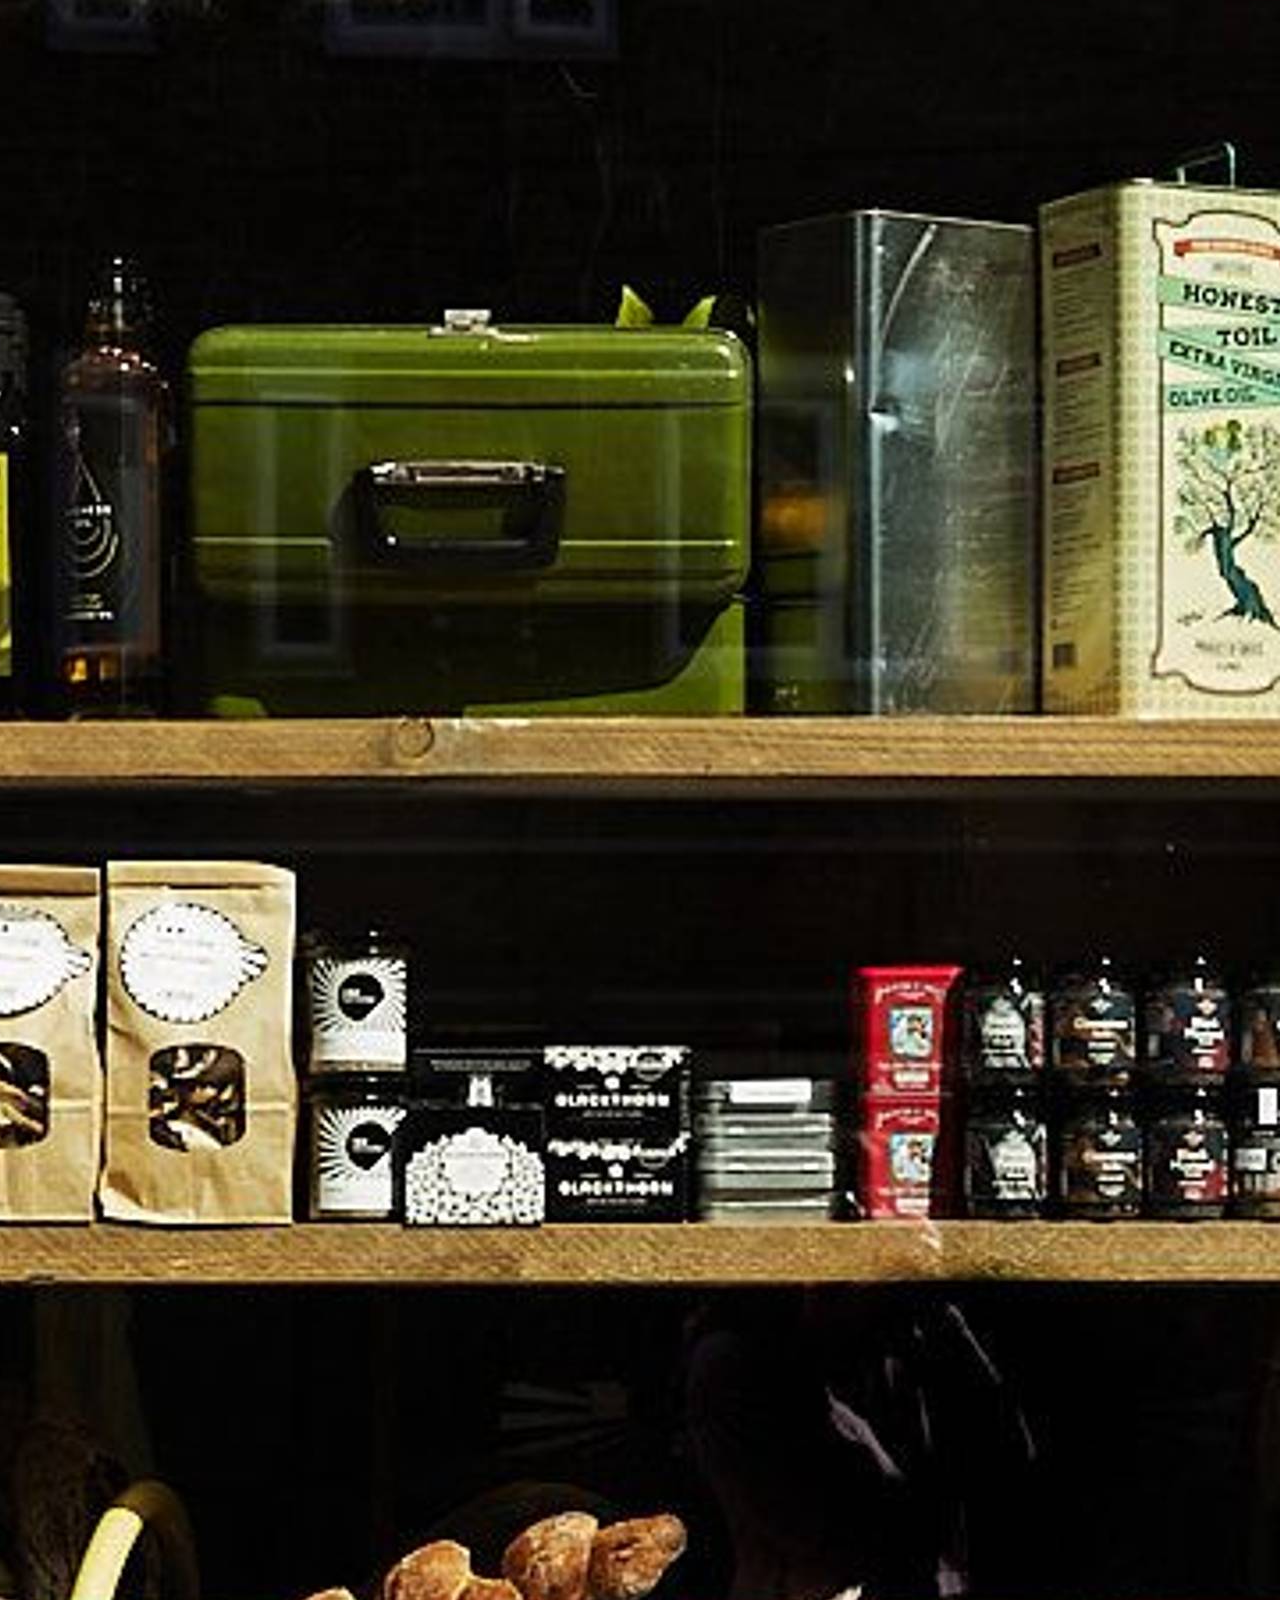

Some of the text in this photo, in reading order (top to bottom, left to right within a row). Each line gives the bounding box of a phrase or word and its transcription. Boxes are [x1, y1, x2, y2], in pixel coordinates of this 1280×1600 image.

[1217, 327, 1277, 346] TOIL
[1170, 341, 1226, 370] EXTRA
[1170, 383, 1257, 407] OLIVE OIL
